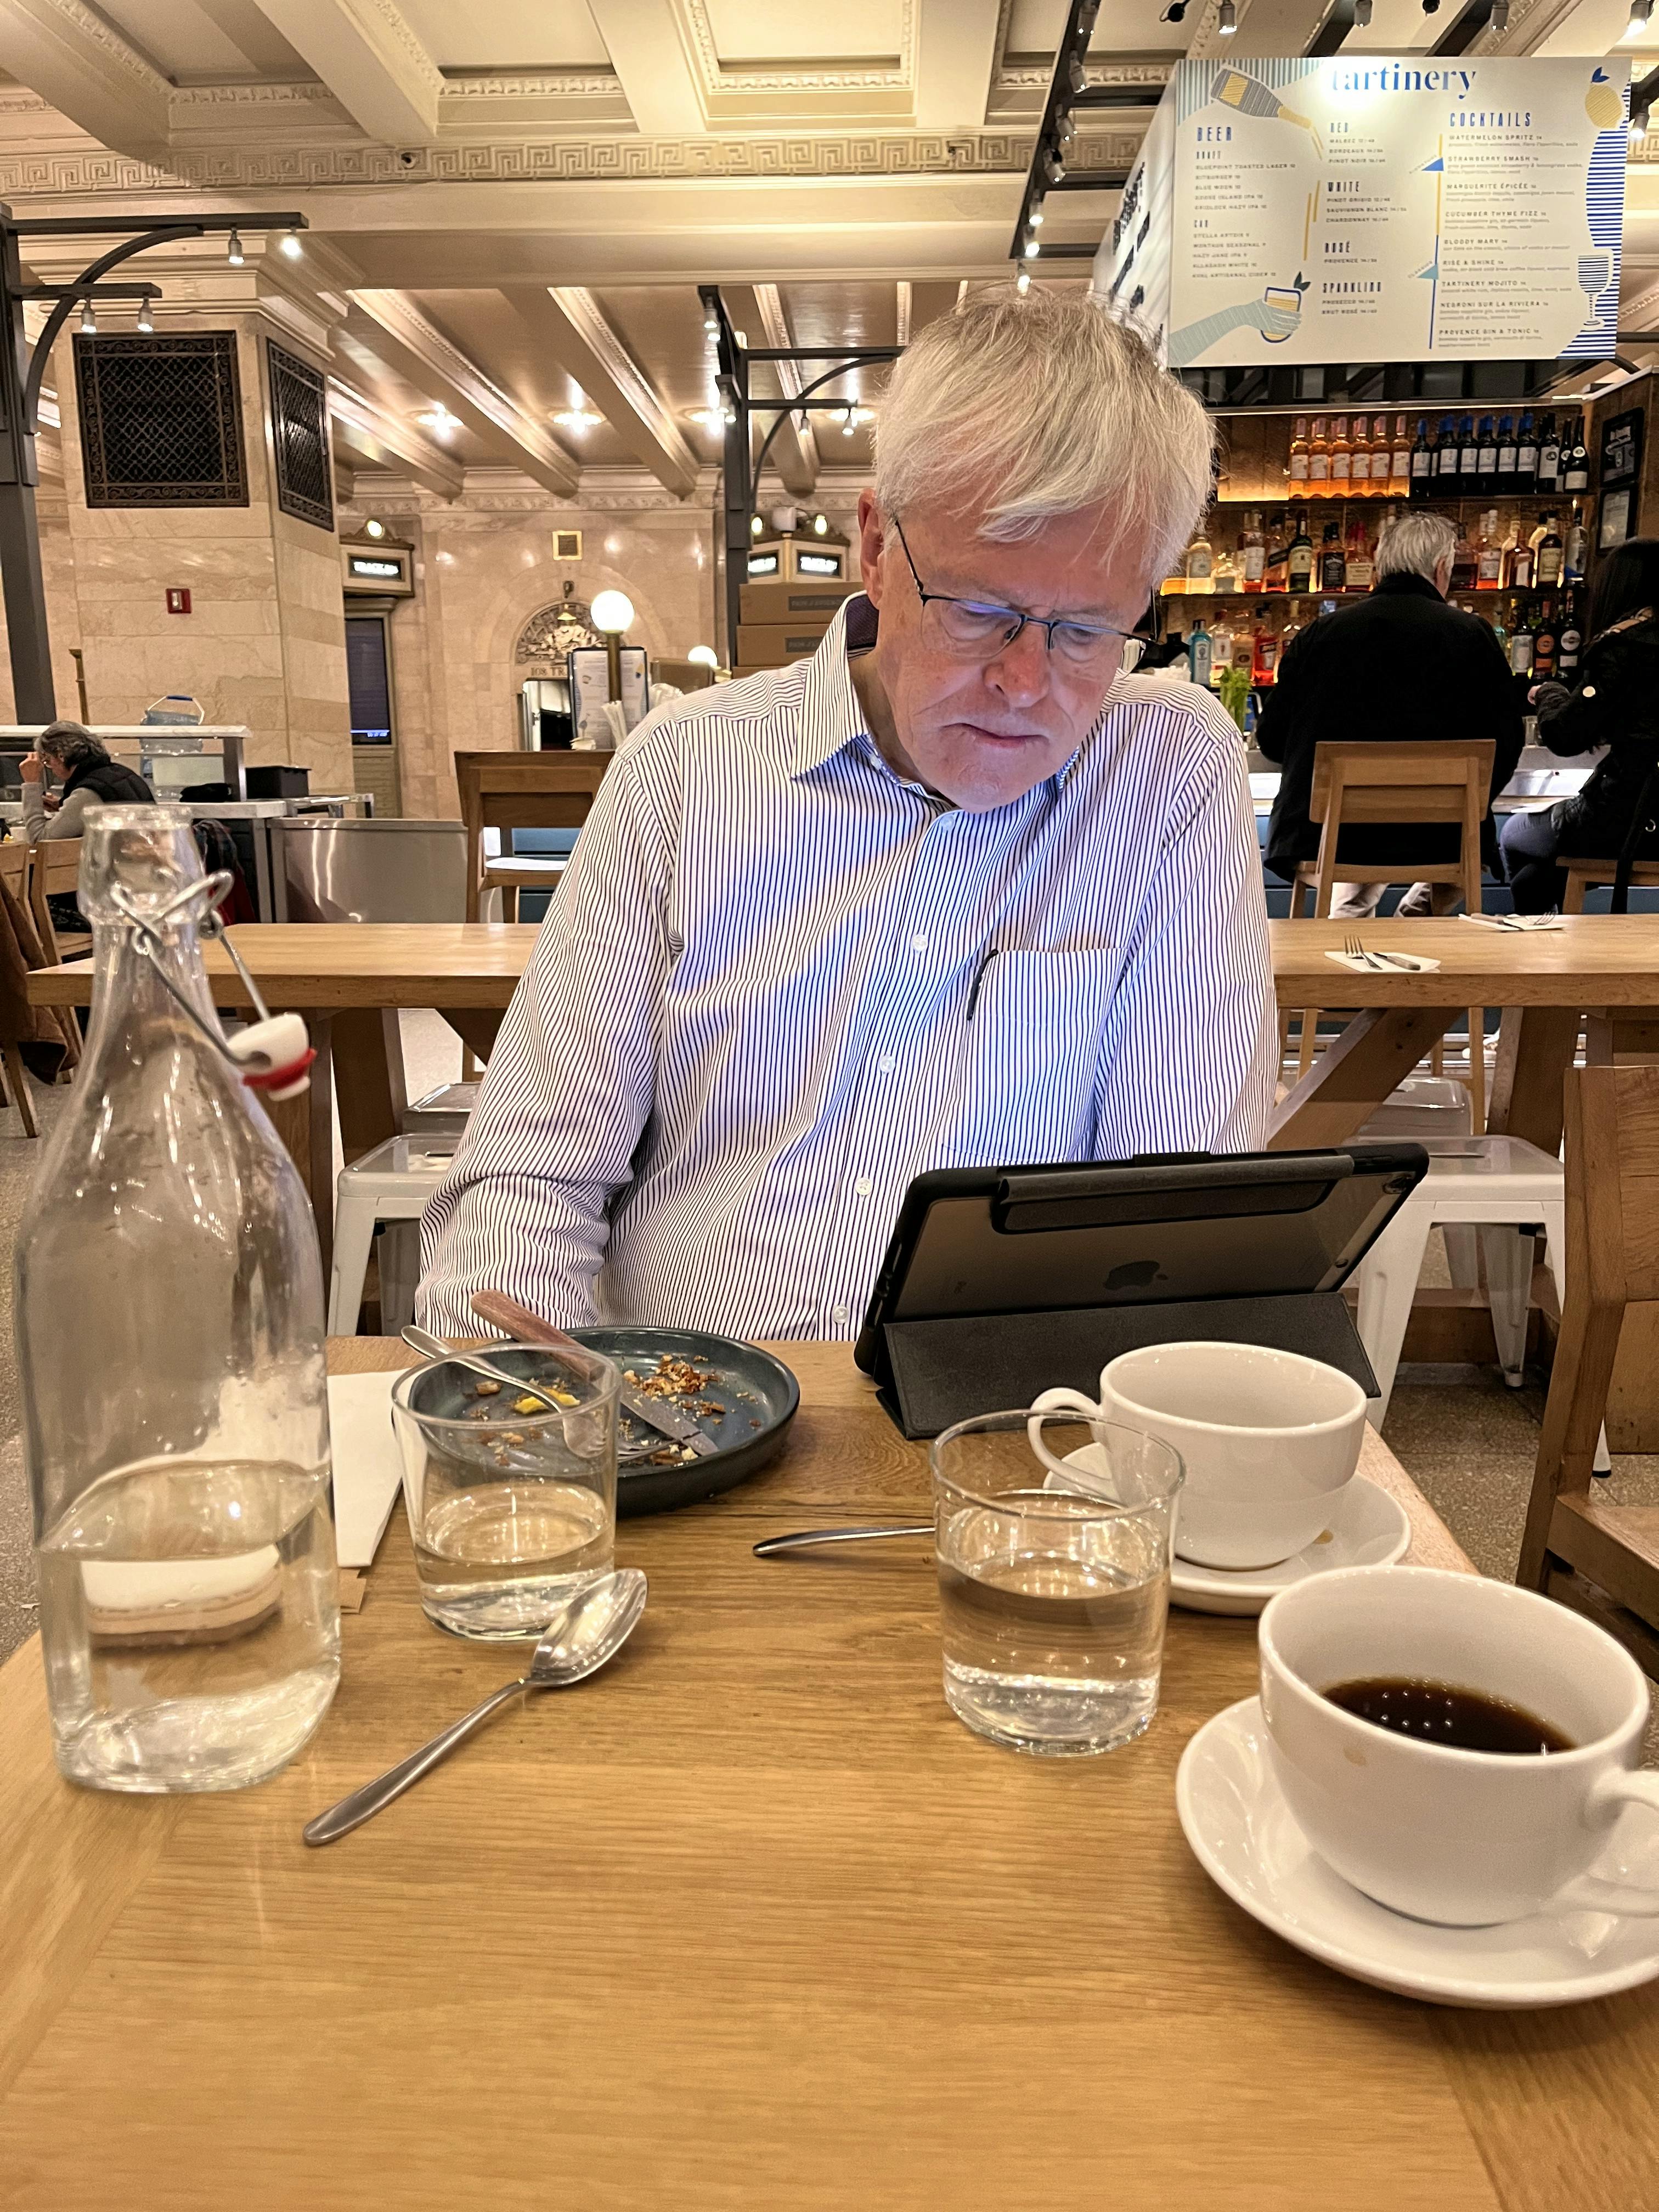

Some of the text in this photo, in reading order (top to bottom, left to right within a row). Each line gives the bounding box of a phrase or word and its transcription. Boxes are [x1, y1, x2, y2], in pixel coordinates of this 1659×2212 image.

[1332, 63, 1476, 99] tartinery
[1450, 112, 1531, 127] COCKTAILS
[1197, 127, 1232, 141] BEER
[1328, 182, 1359, 192] WHITE
